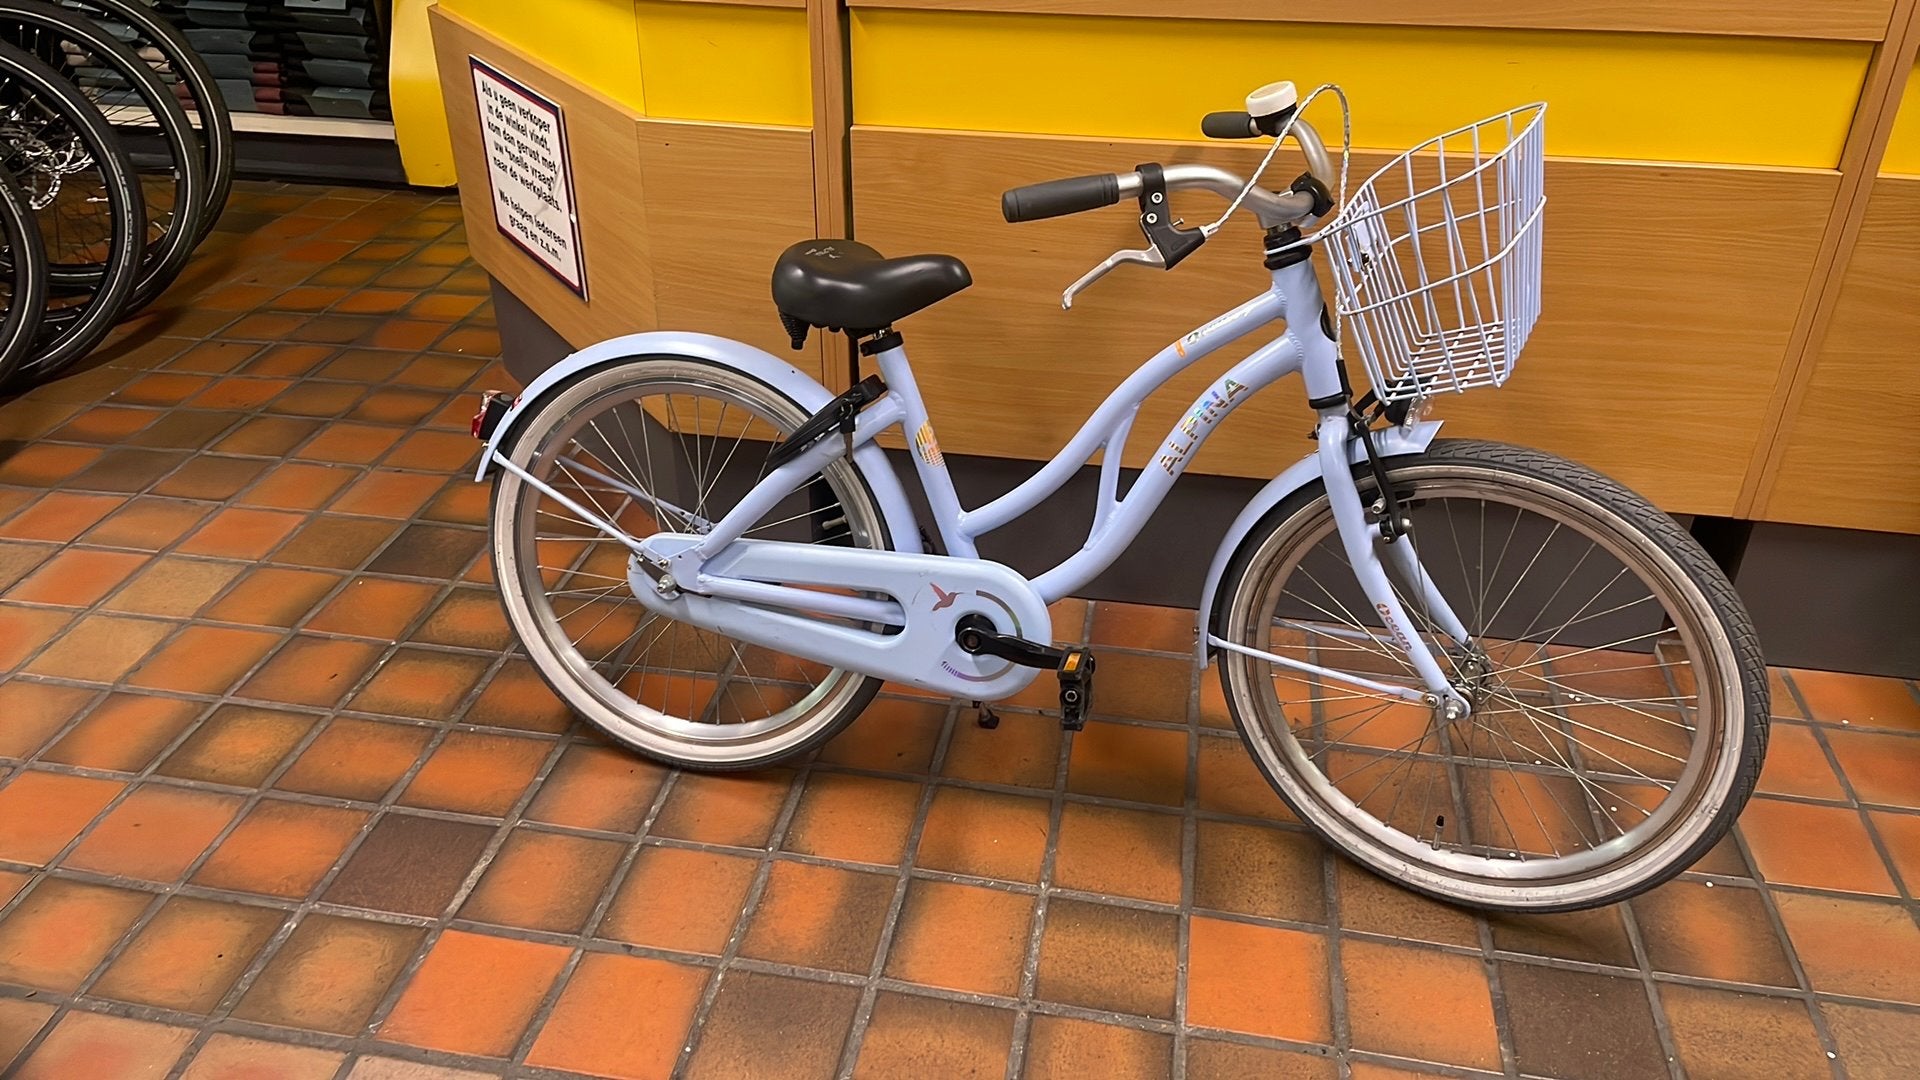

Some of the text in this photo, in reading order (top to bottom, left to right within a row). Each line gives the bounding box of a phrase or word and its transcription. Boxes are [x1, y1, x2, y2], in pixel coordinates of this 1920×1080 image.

[482, 81, 492, 97] Als
[500, 95, 516, 112] geen
[518, 106, 550, 133] verkoper
[487, 100, 493, 115] in
[495, 107, 503, 121] de
[505, 115, 527, 137] winkel
[487, 117, 558, 176] kom dan gerust met
[493, 157, 507, 173] naar
[510, 166, 518, 181] de
[499, 188, 567, 249] We helpen iedereen
[509, 215, 528, 239] graag
[530, 231, 538, 244] en
[1159, 377, 1249, 477] ALPINA
[1376, 603, 1412, 652] Ocean
